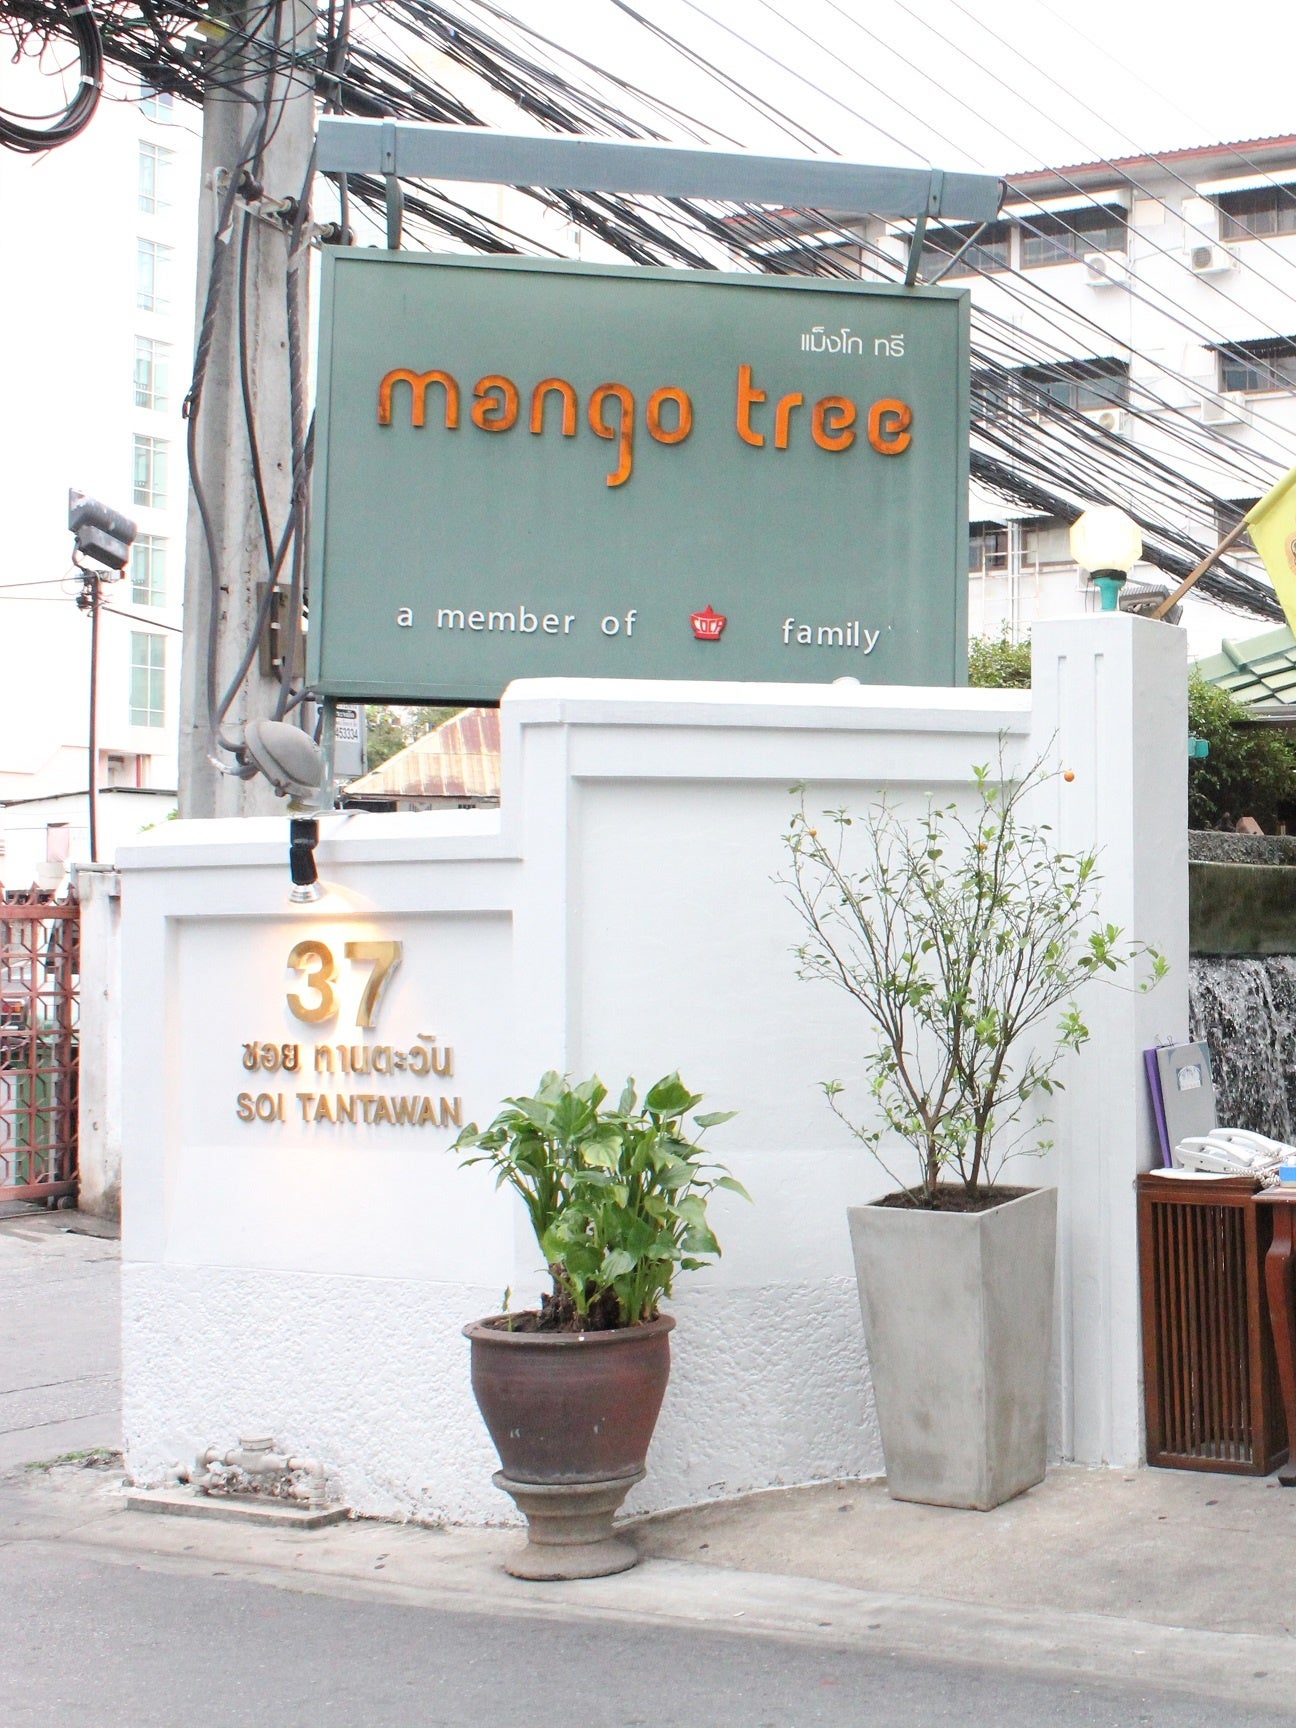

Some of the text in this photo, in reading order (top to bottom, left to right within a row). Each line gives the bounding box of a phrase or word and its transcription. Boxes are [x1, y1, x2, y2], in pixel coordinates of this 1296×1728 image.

[801, 326, 905, 357] แม็งโก ทรี
[376, 363, 914, 488] mango tree
[397, 606, 414, 628] a
[437, 605, 576, 634] member
[601, 609, 638, 636] of
[781, 617, 880, 655] family
[286, 940, 403, 1028] 37
[314, 1033, 454, 1076] ทานตะวัน
[236, 1092, 462, 1128] SOI TANTAWAN
